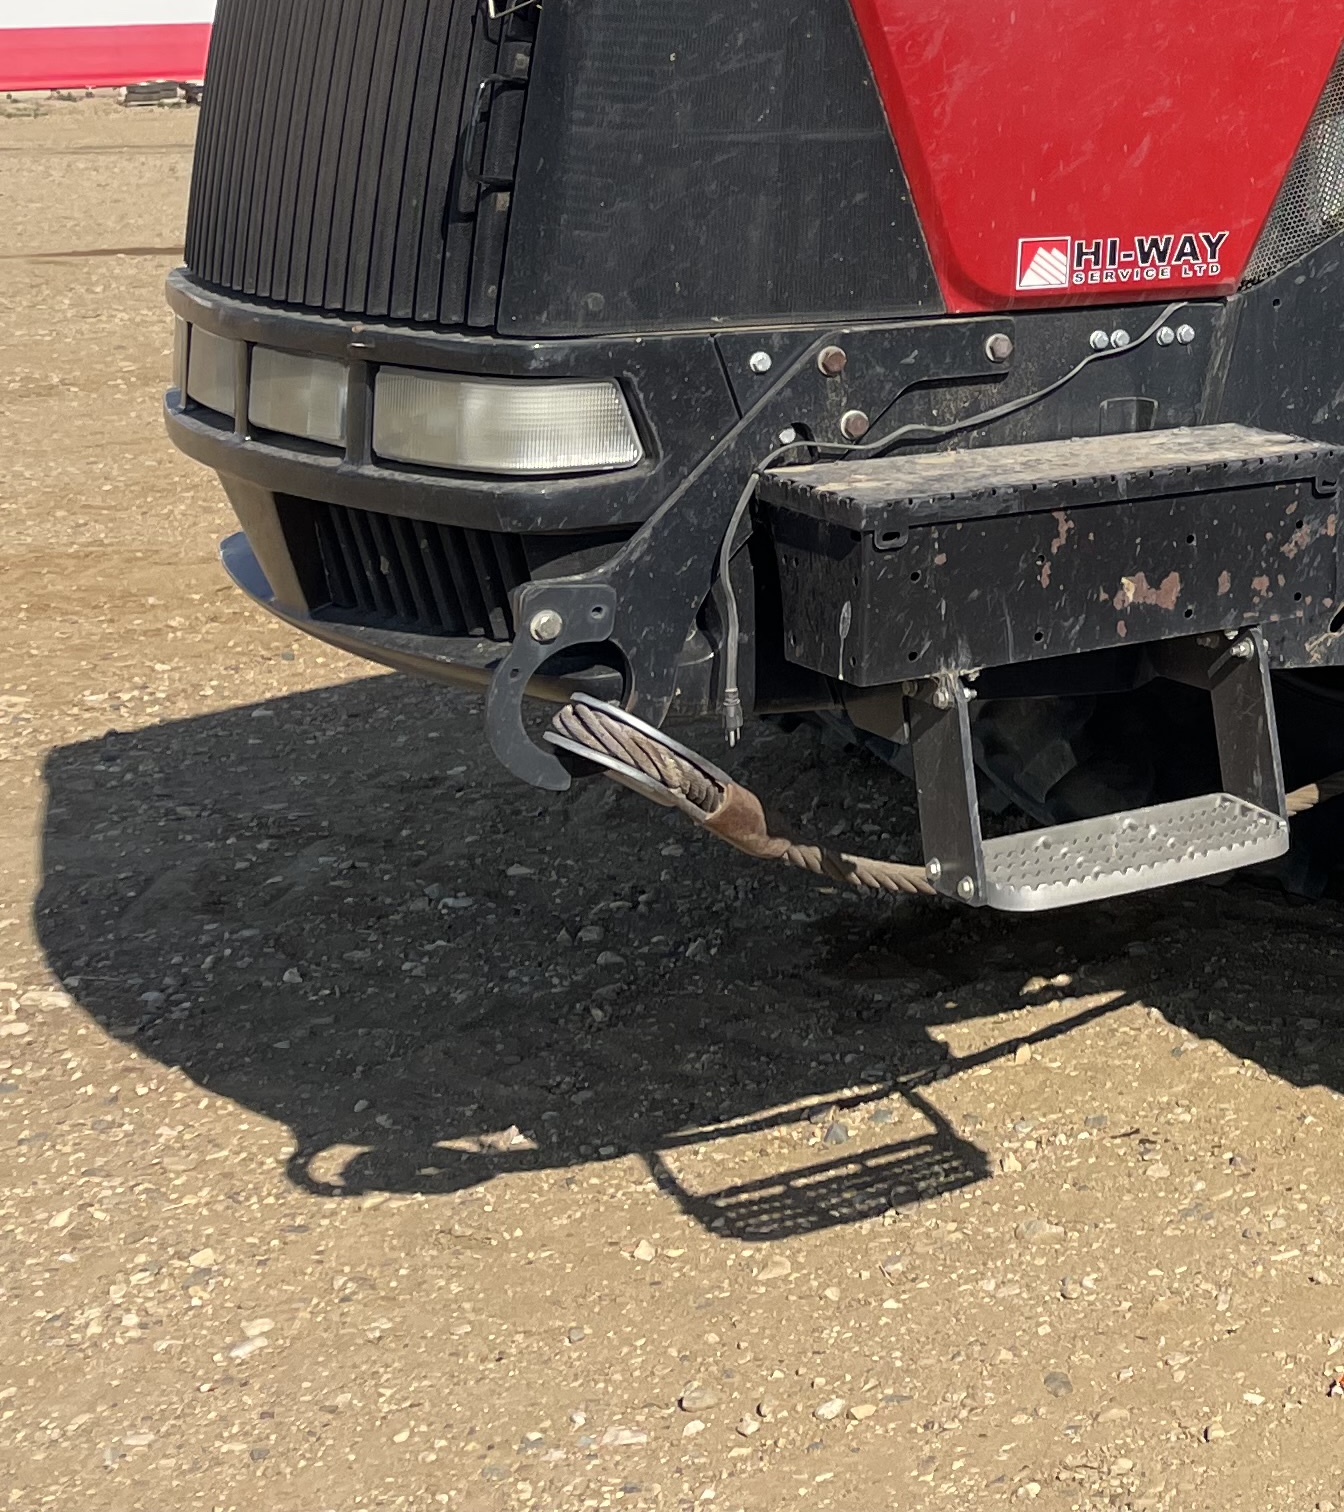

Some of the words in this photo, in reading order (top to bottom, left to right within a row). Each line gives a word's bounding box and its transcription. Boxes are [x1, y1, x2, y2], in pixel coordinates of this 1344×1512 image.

[1073, 230, 1230, 271] HI-WAY
[1072, 265, 1172, 285] SERVICE
[1181, 262, 1221, 278] LTD
